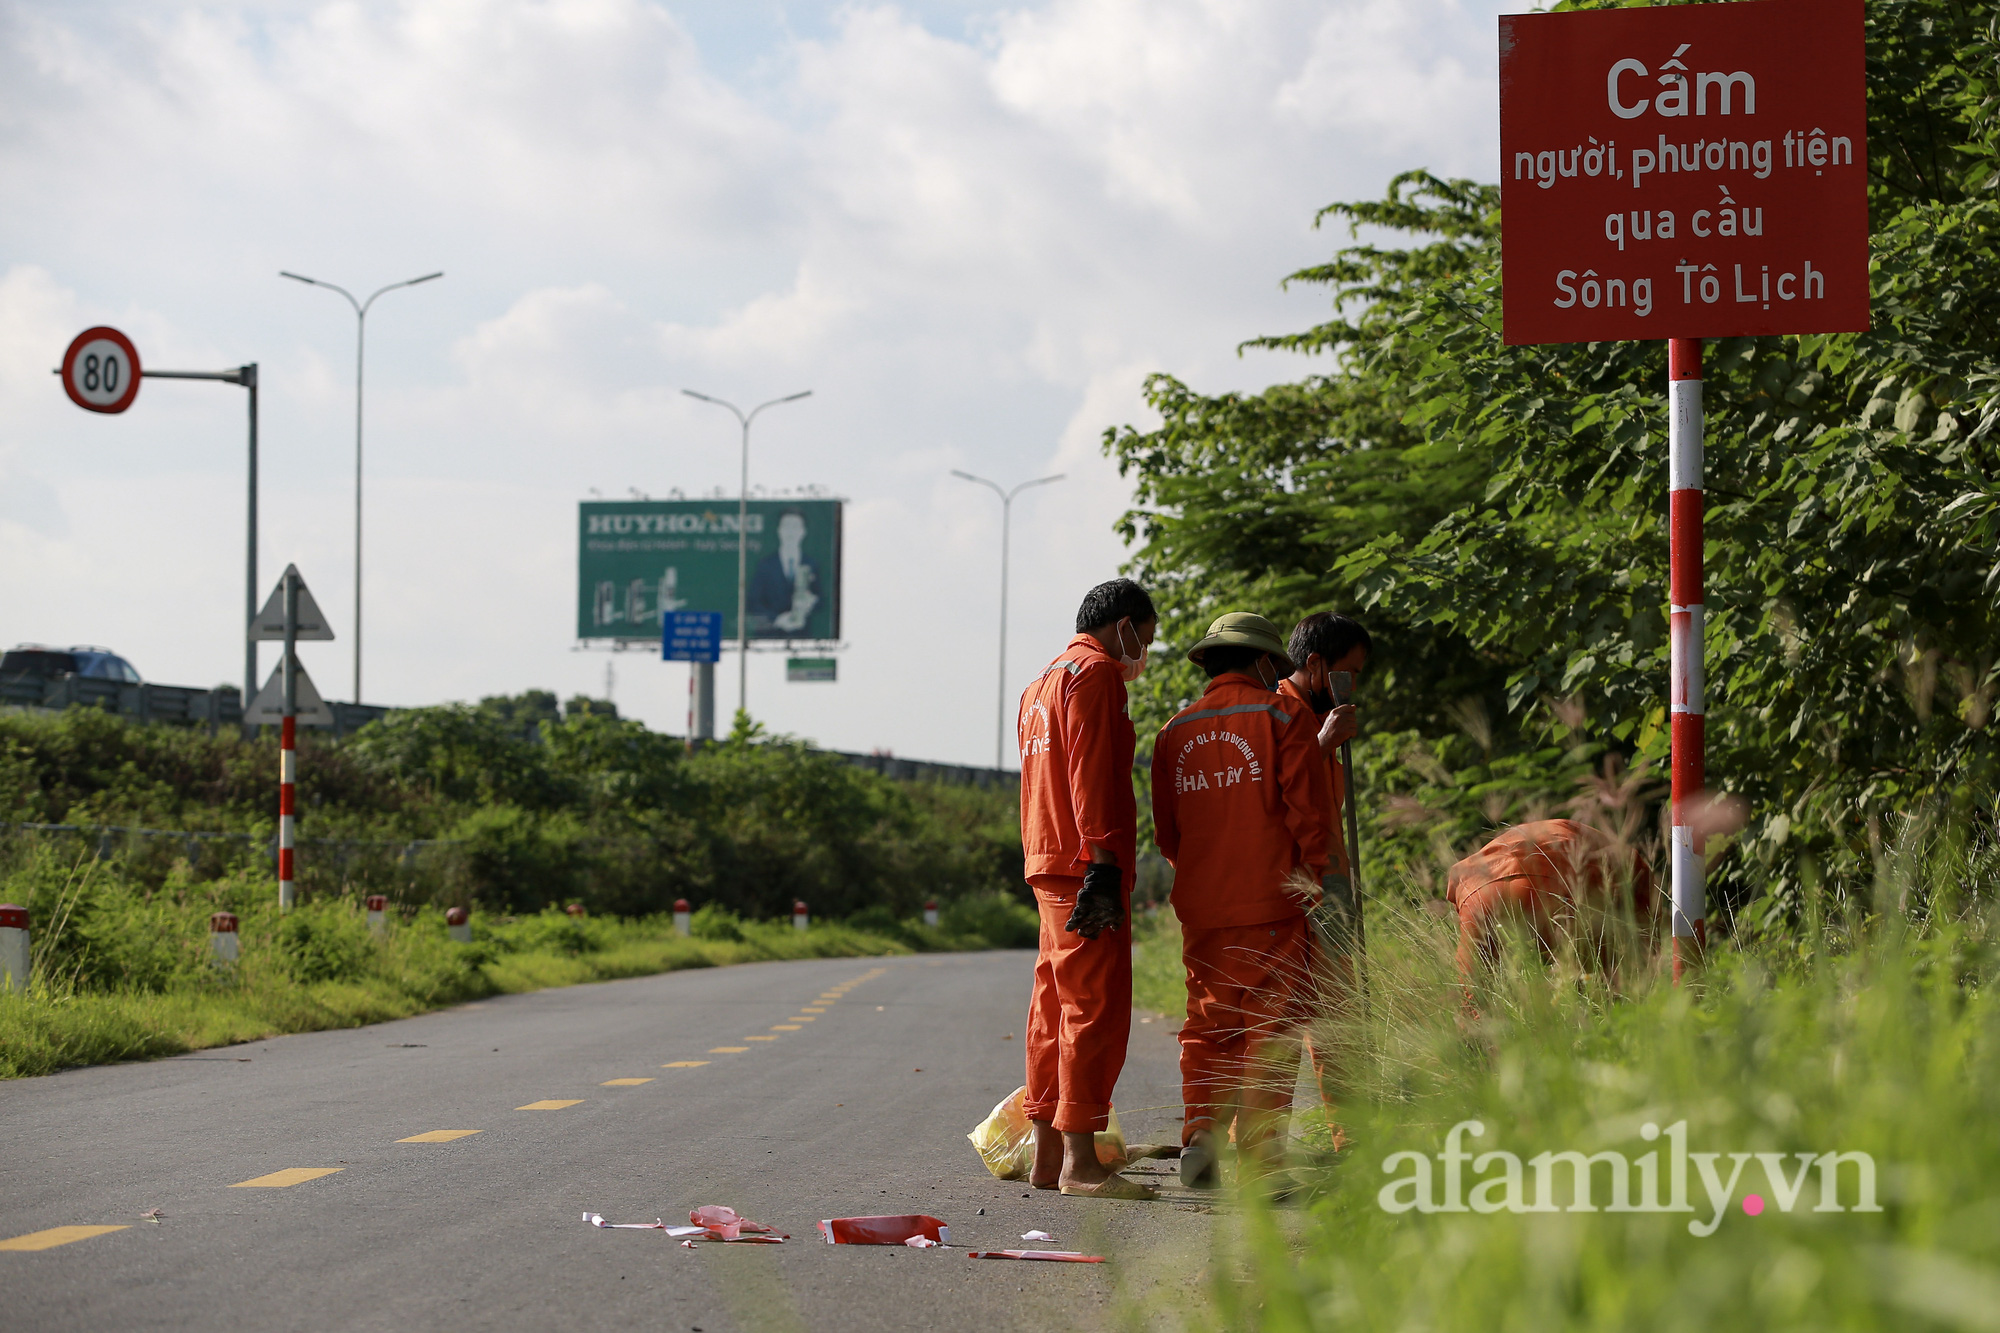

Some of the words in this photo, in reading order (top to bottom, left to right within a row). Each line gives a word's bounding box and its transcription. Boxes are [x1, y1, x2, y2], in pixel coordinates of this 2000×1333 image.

[1606, 43, 1756, 119] Cấm
[1514, 135, 1624, 189] người,
[1632, 134, 1772, 189] phương
[1782, 127, 1853, 177] tiện
[1605, 209, 1676, 251] qua
[1692, 184, 1763, 238] cầu
[1553, 269, 1653, 317] Sông
[1675, 263, 1721, 304] Tô
[1734, 260, 1825, 311] Lịch
[84, 353, 119, 393] 80
[1177, 752, 1186, 765] TY
[1183, 740, 1194, 753] CP
[1196, 733, 1210, 745] QL
[1210, 730, 1217, 741] &
[1248, 760, 1263, 775] BỘ
[1182, 769, 1210, 792] HÀ
[1213, 765, 1244, 788] TÂY
